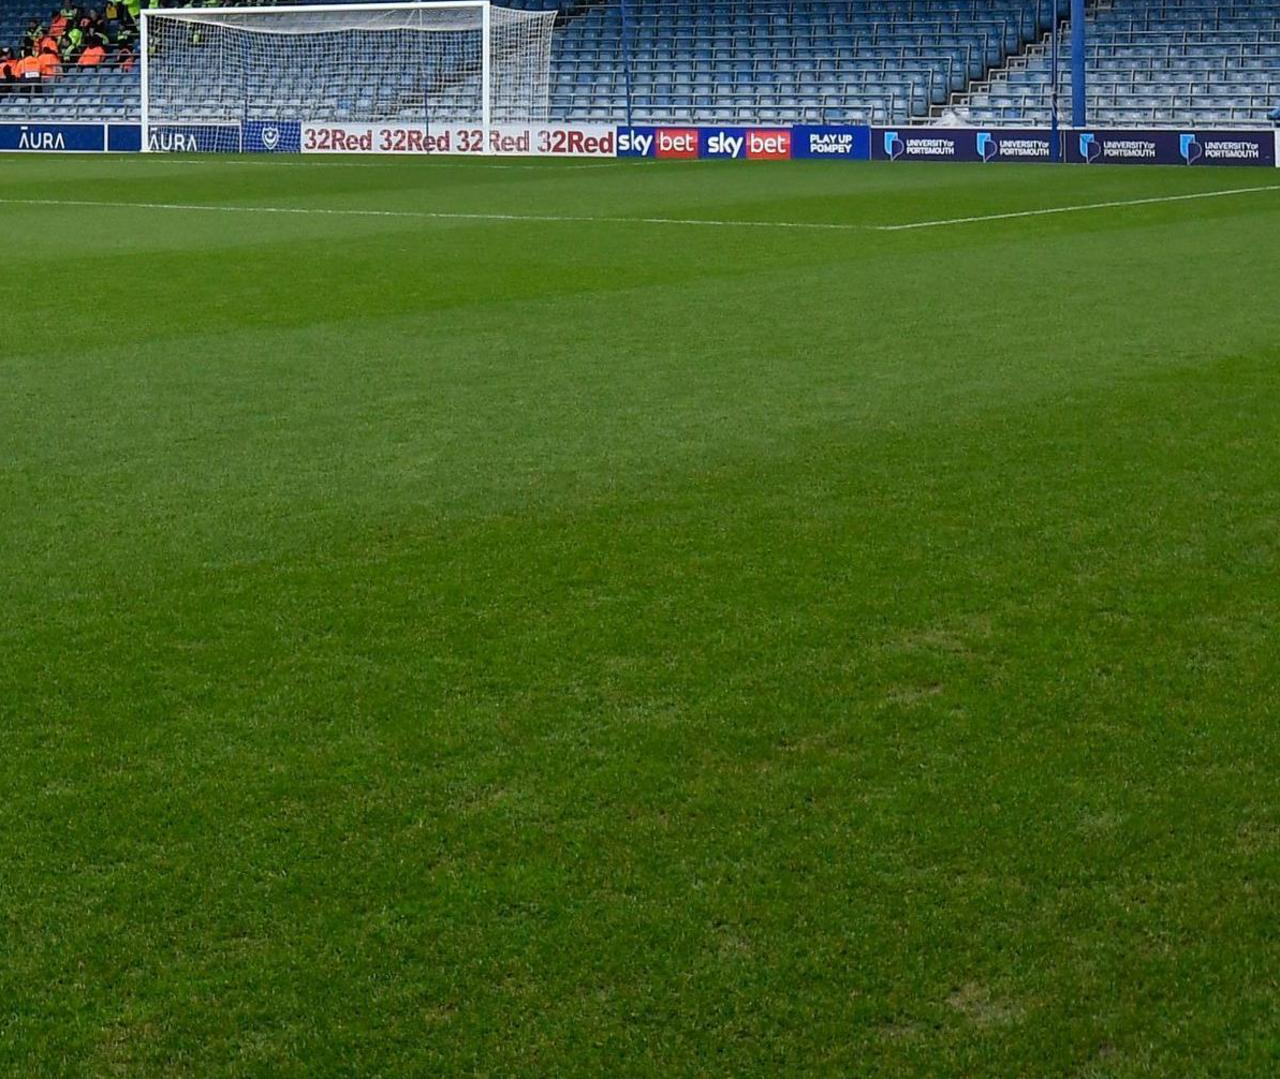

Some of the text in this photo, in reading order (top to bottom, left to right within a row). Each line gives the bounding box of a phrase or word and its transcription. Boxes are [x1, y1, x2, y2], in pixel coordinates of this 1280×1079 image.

[304, 128, 372, 151] 32Red
[379, 128, 449, 152] 32Red
[537, 129, 613, 154] 32Red
[619, 130, 694, 156] sky bet
[810, 134, 853, 144] PLAY UP
[707, 132, 787, 158] sky bet
[810, 144, 853, 153] POMPEY
[906, 147, 955, 155] PORTSMOUTH
[999, 148, 1050, 156] PORTSMOUTH
[1104, 149, 1156, 157] PORTSMOUTH
[1205, 150, 1259, 158] PORTSMOUTH
